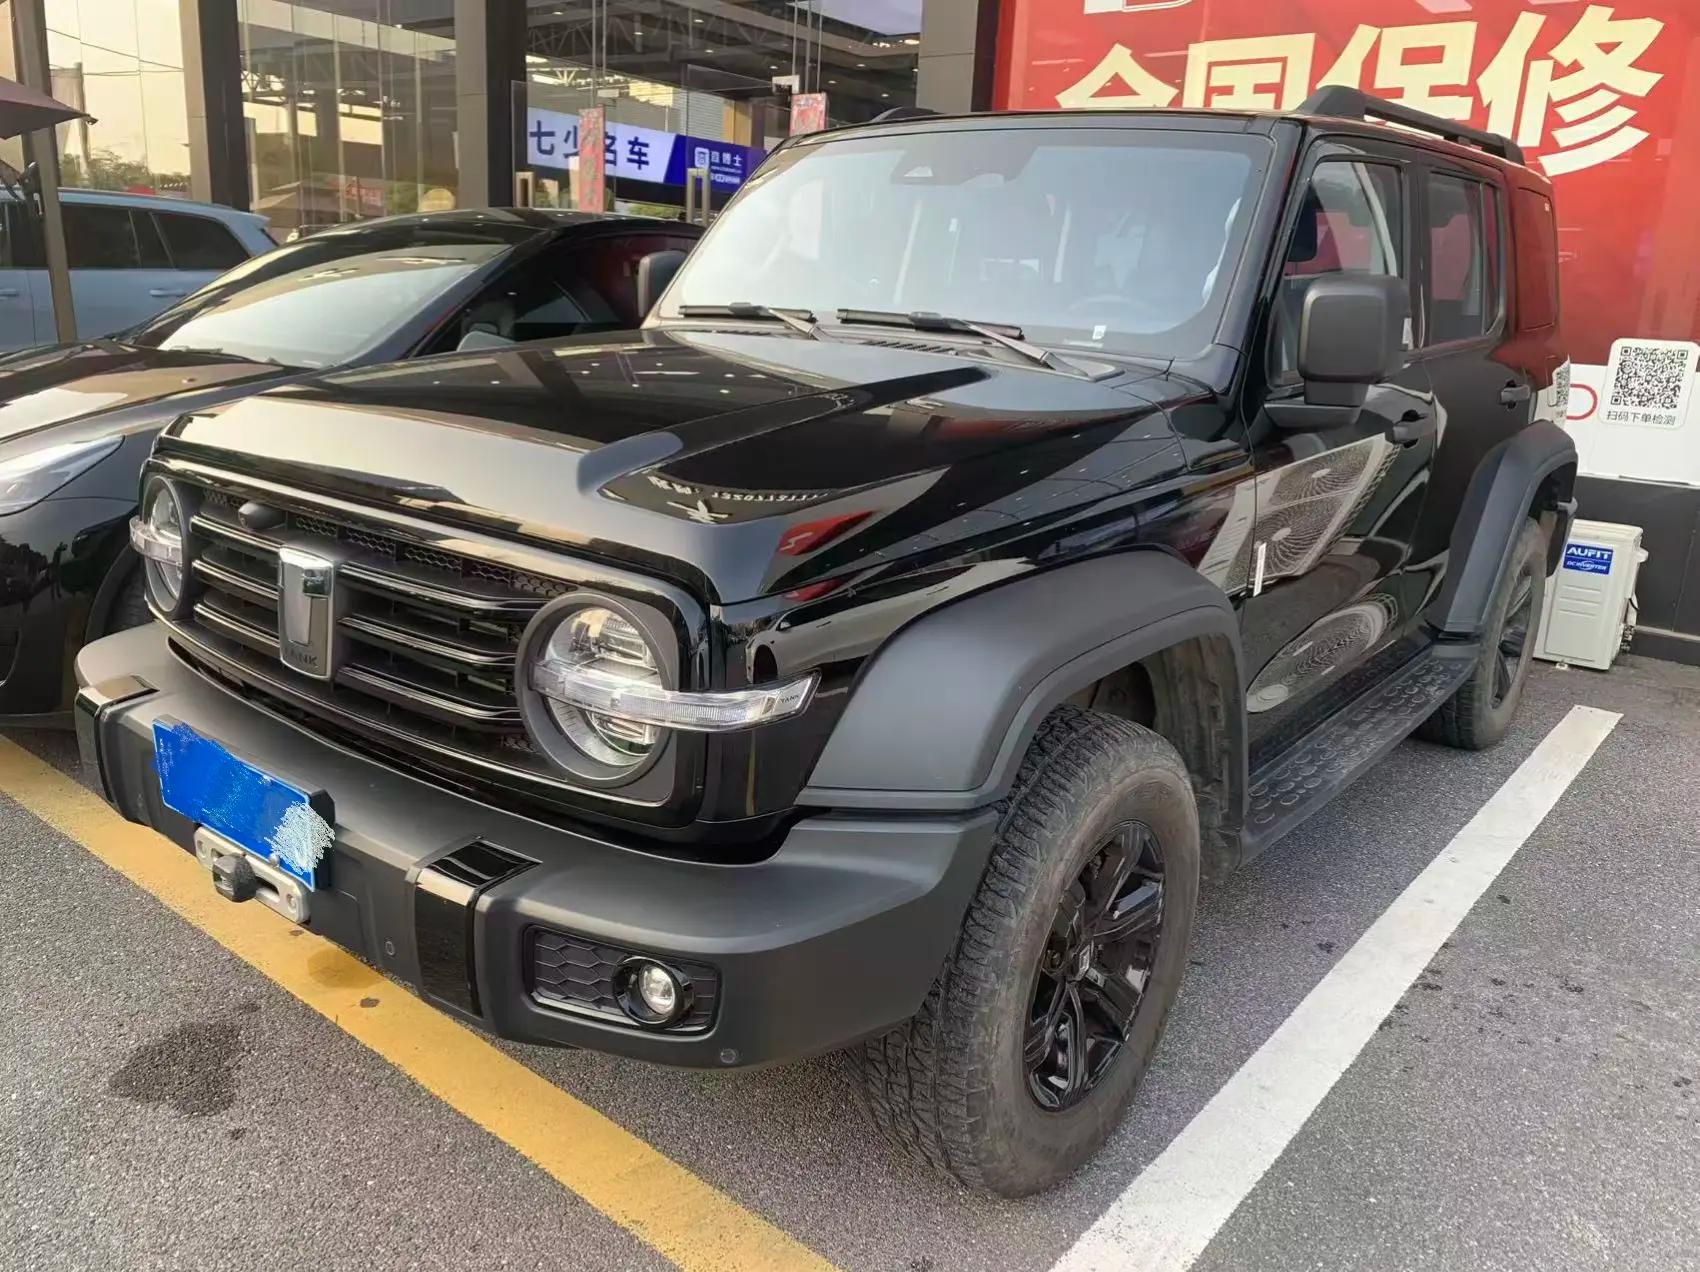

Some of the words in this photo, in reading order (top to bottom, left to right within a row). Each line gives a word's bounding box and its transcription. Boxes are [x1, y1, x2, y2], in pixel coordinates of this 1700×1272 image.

[1607, 410, 1676, 426] 扫码下单检测
[1567, 547, 1612, 560] AUFIT
